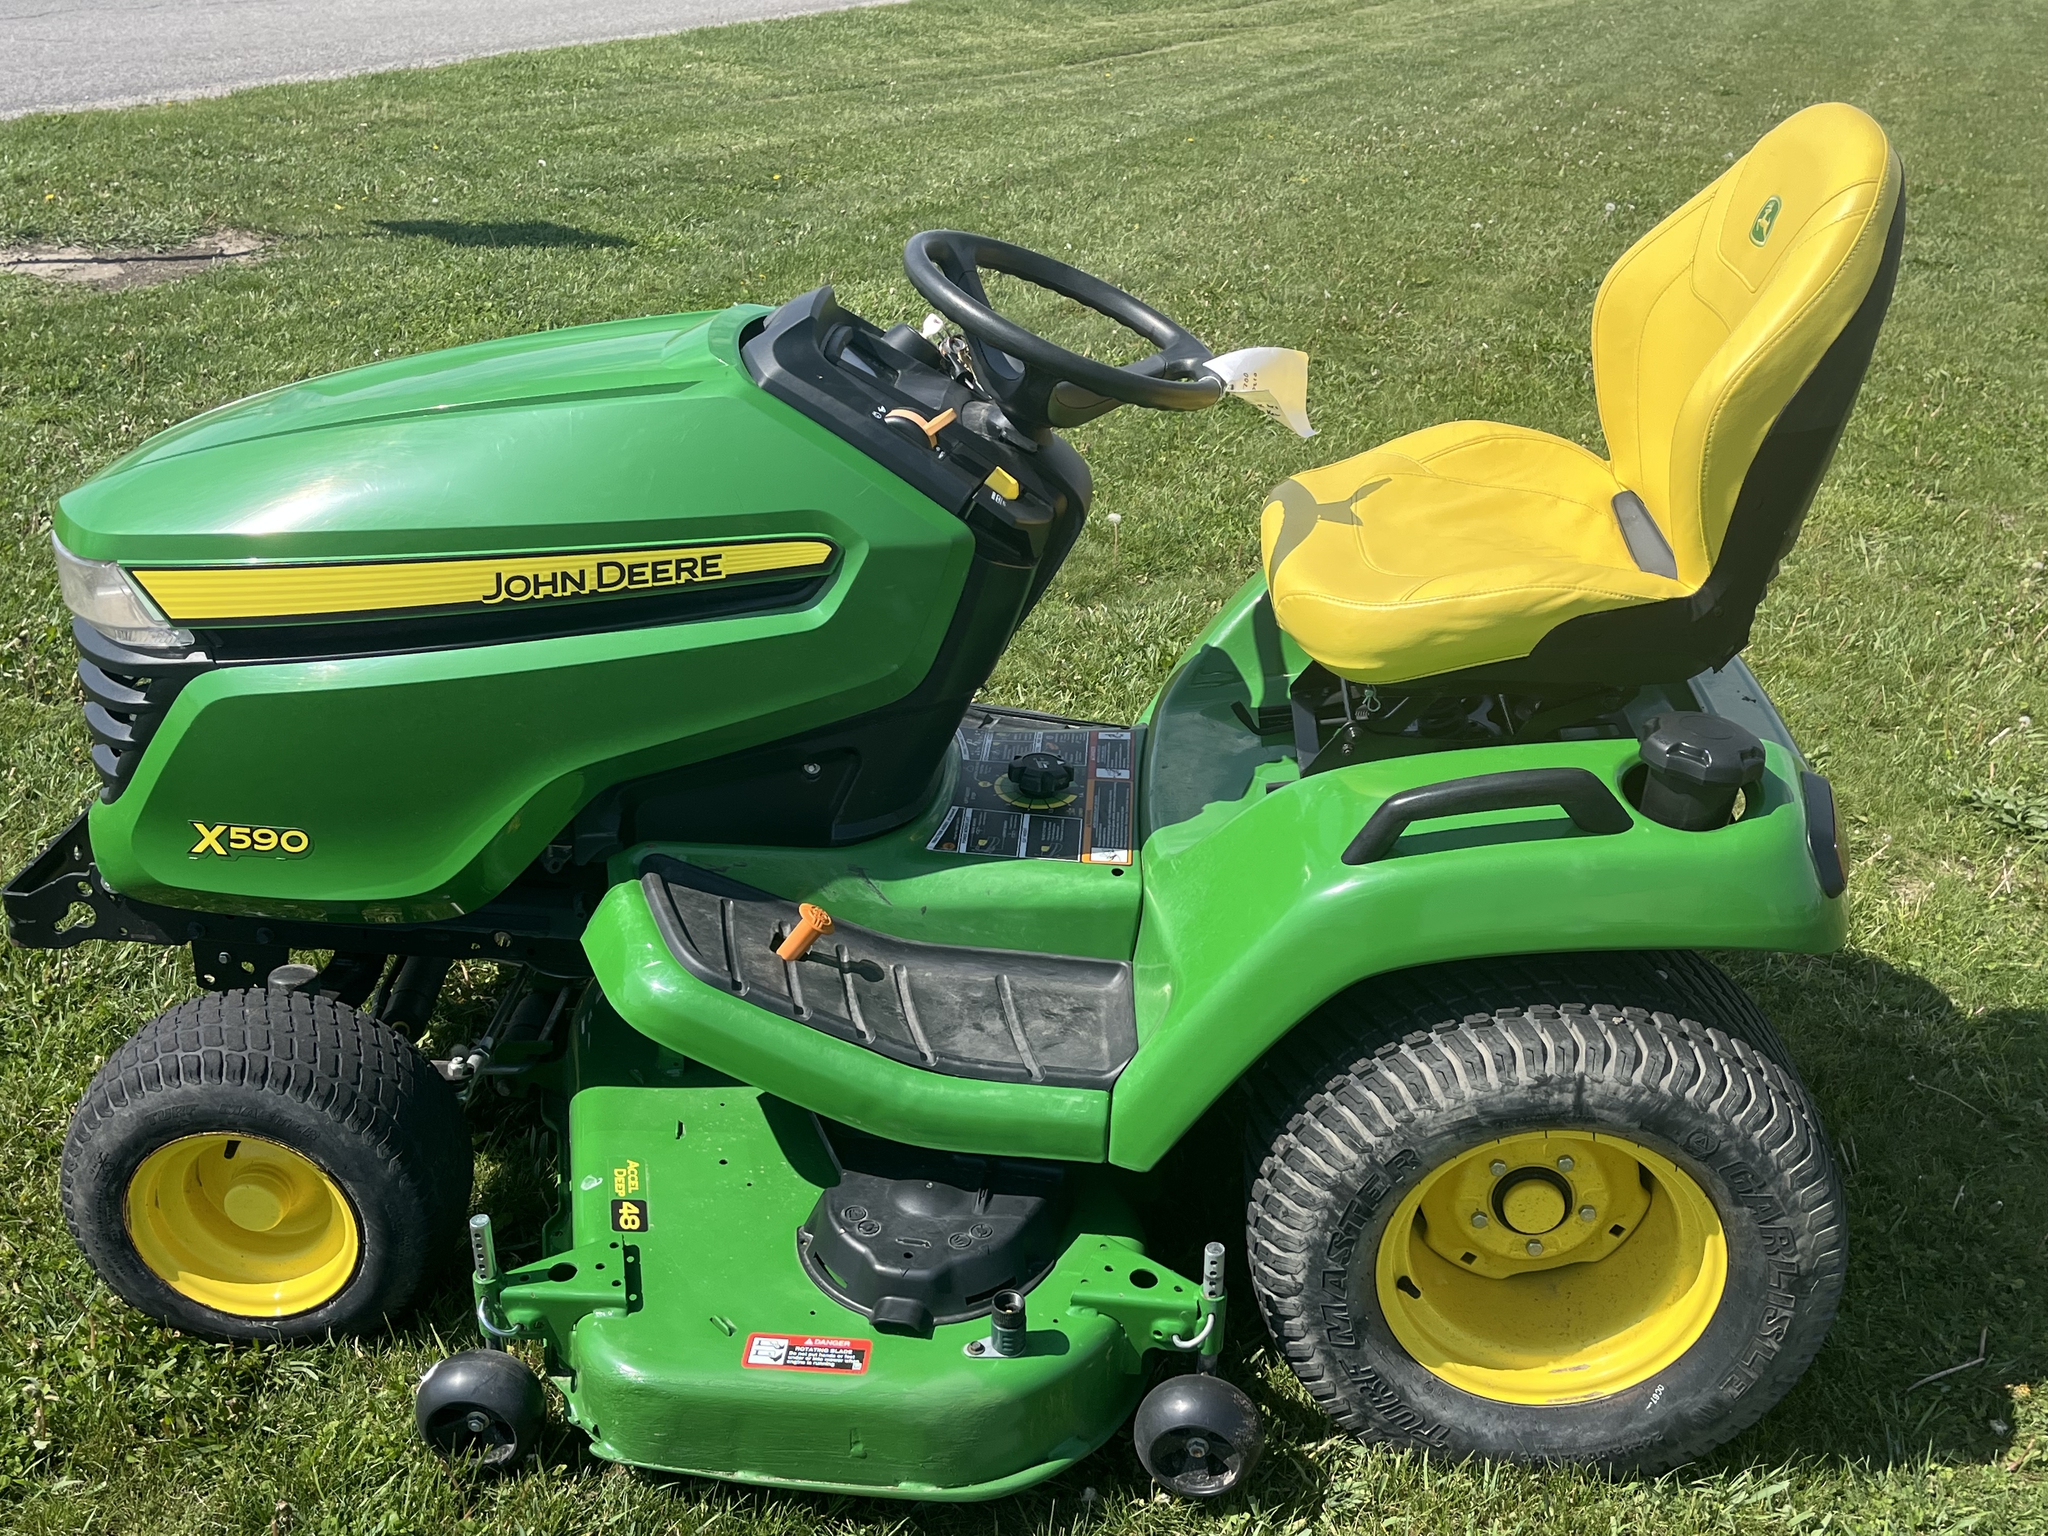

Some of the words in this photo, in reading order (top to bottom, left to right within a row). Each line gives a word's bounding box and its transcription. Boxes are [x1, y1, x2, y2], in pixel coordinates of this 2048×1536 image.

[482, 570, 587, 602] JOHN
[597, 552, 723, 591] DEERE
[190, 822, 309, 856] X590
[144, 1103, 200, 1127] TURF
[614, 1168, 627, 1197] DEEP
[627, 1159, 640, 1194] ACCEL
[618, 1201, 641, 1230] 48
[1322, 1147, 1421, 1347] MASTER
[1717, 1161, 1800, 1401] CARLISLE
[795, 1346, 829, 1354] ROTATING
[814, 1338, 851, 1347] DANGER
